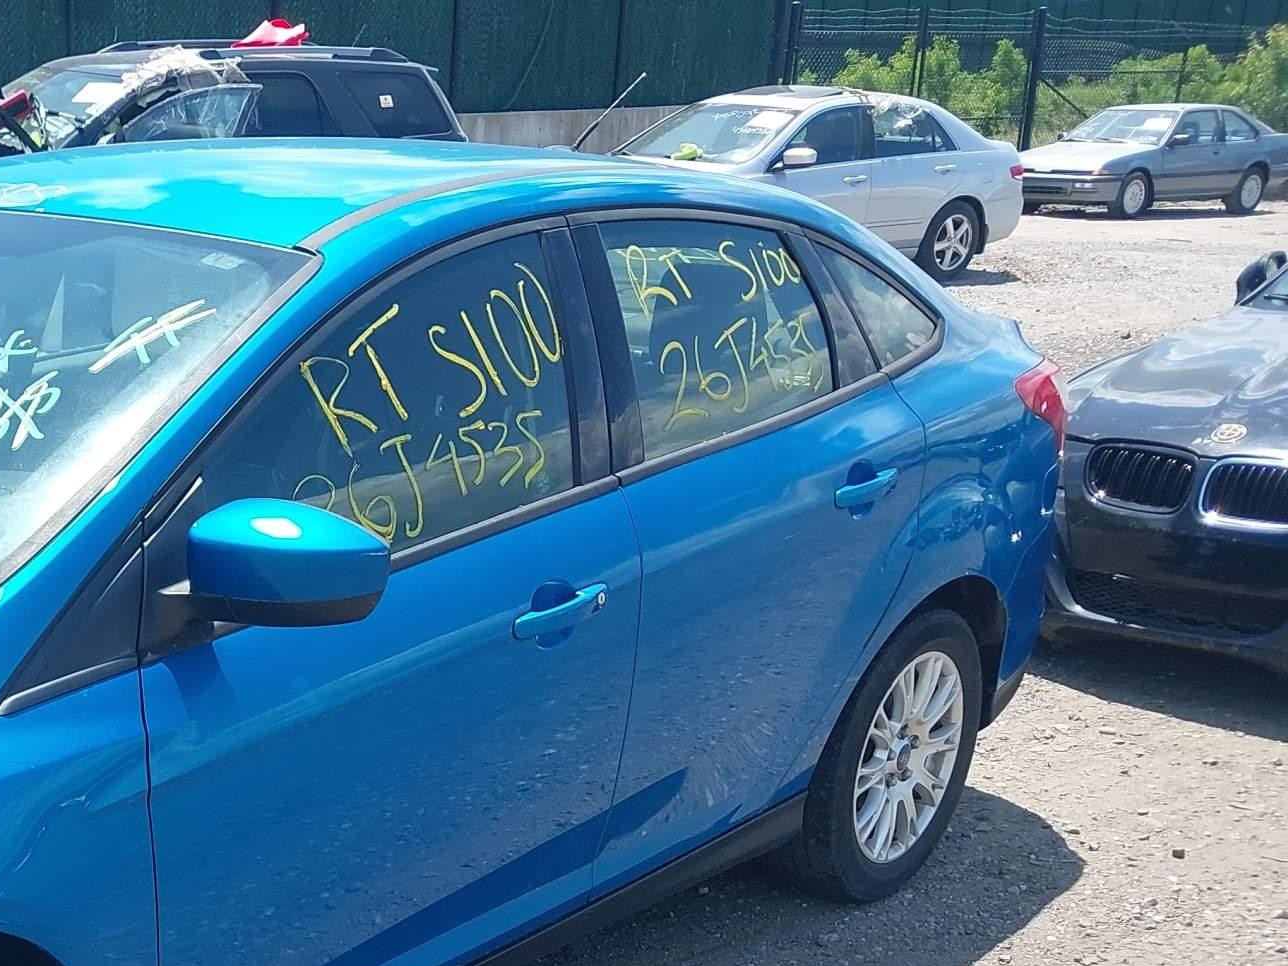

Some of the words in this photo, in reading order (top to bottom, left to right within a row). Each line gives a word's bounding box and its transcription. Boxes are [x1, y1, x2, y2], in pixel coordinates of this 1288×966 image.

[626, 244, 693, 322] RT
[718, 239, 802, 302] S100
[298, 302, 410, 459] RT
[427, 261, 562, 419] S100
